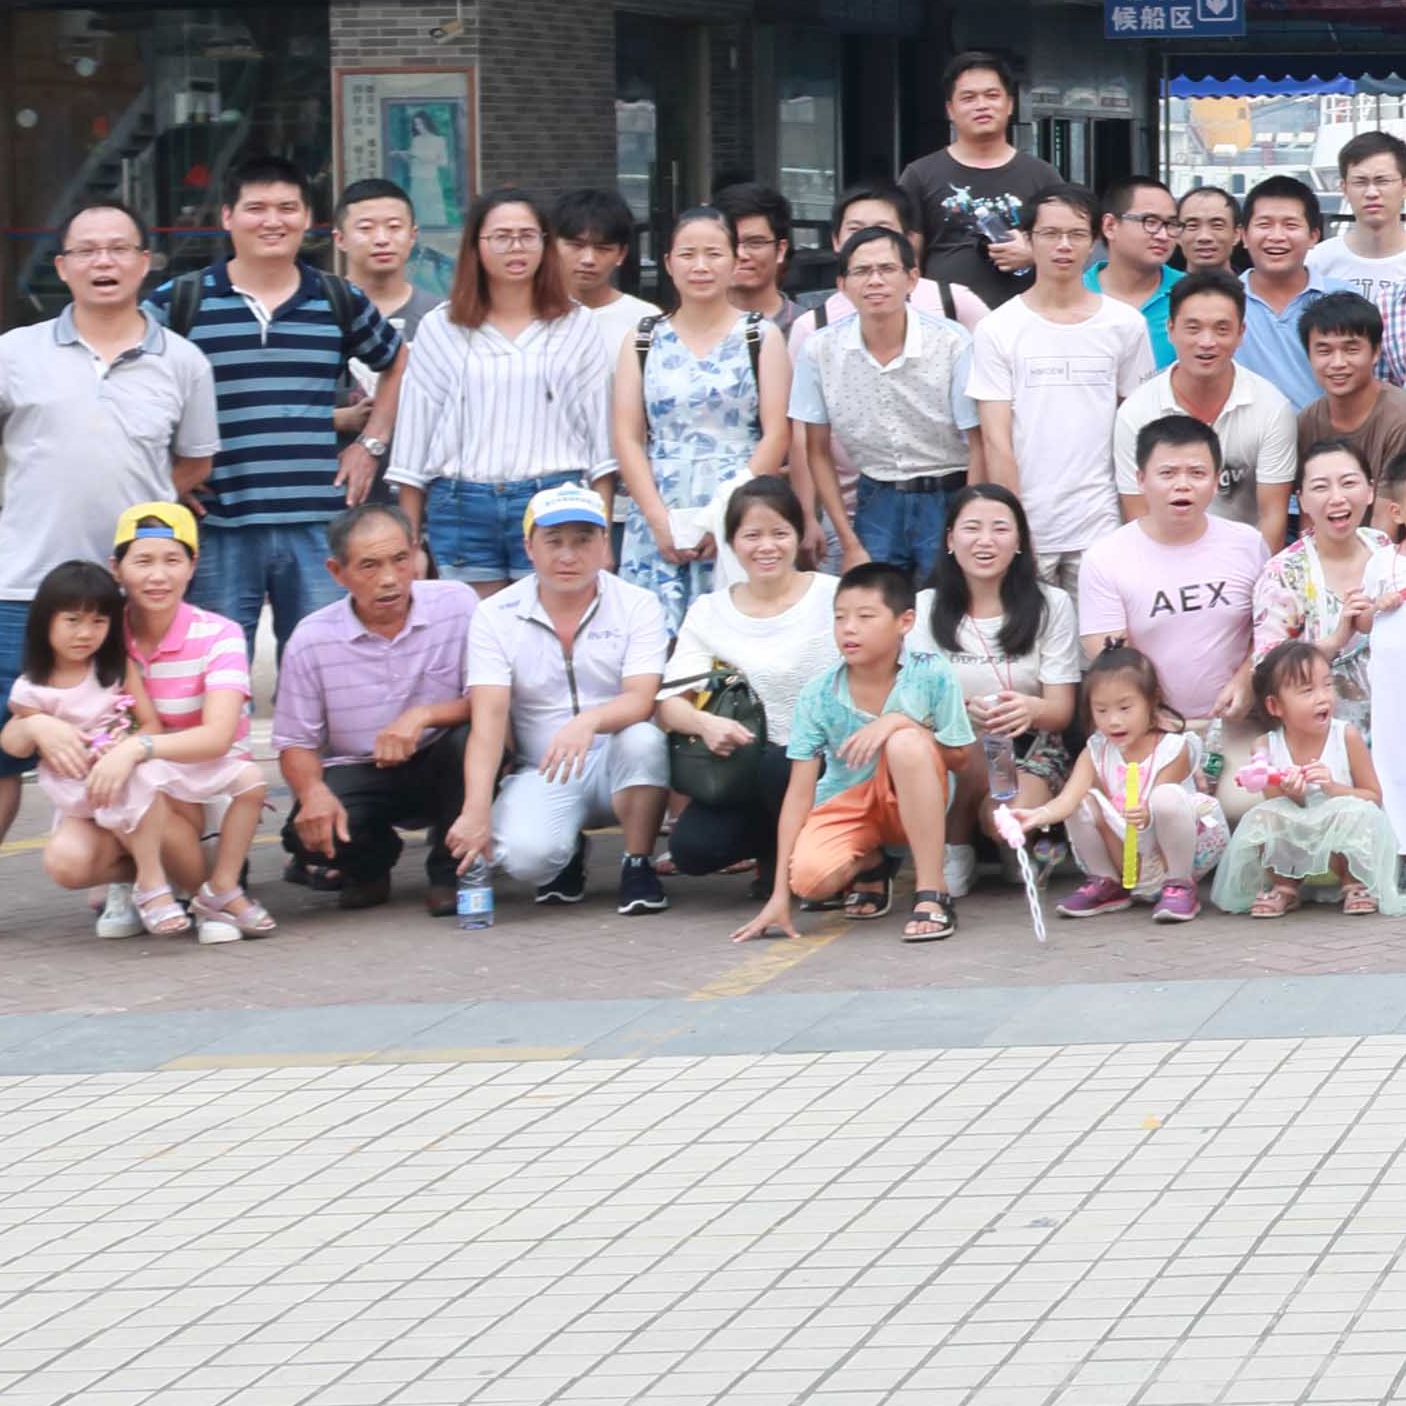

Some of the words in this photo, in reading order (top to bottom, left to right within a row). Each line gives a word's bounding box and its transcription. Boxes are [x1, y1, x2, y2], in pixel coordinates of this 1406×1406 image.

[1111, 4, 1195, 32] 候船区
[1149, 580, 1232, 618] AEX
